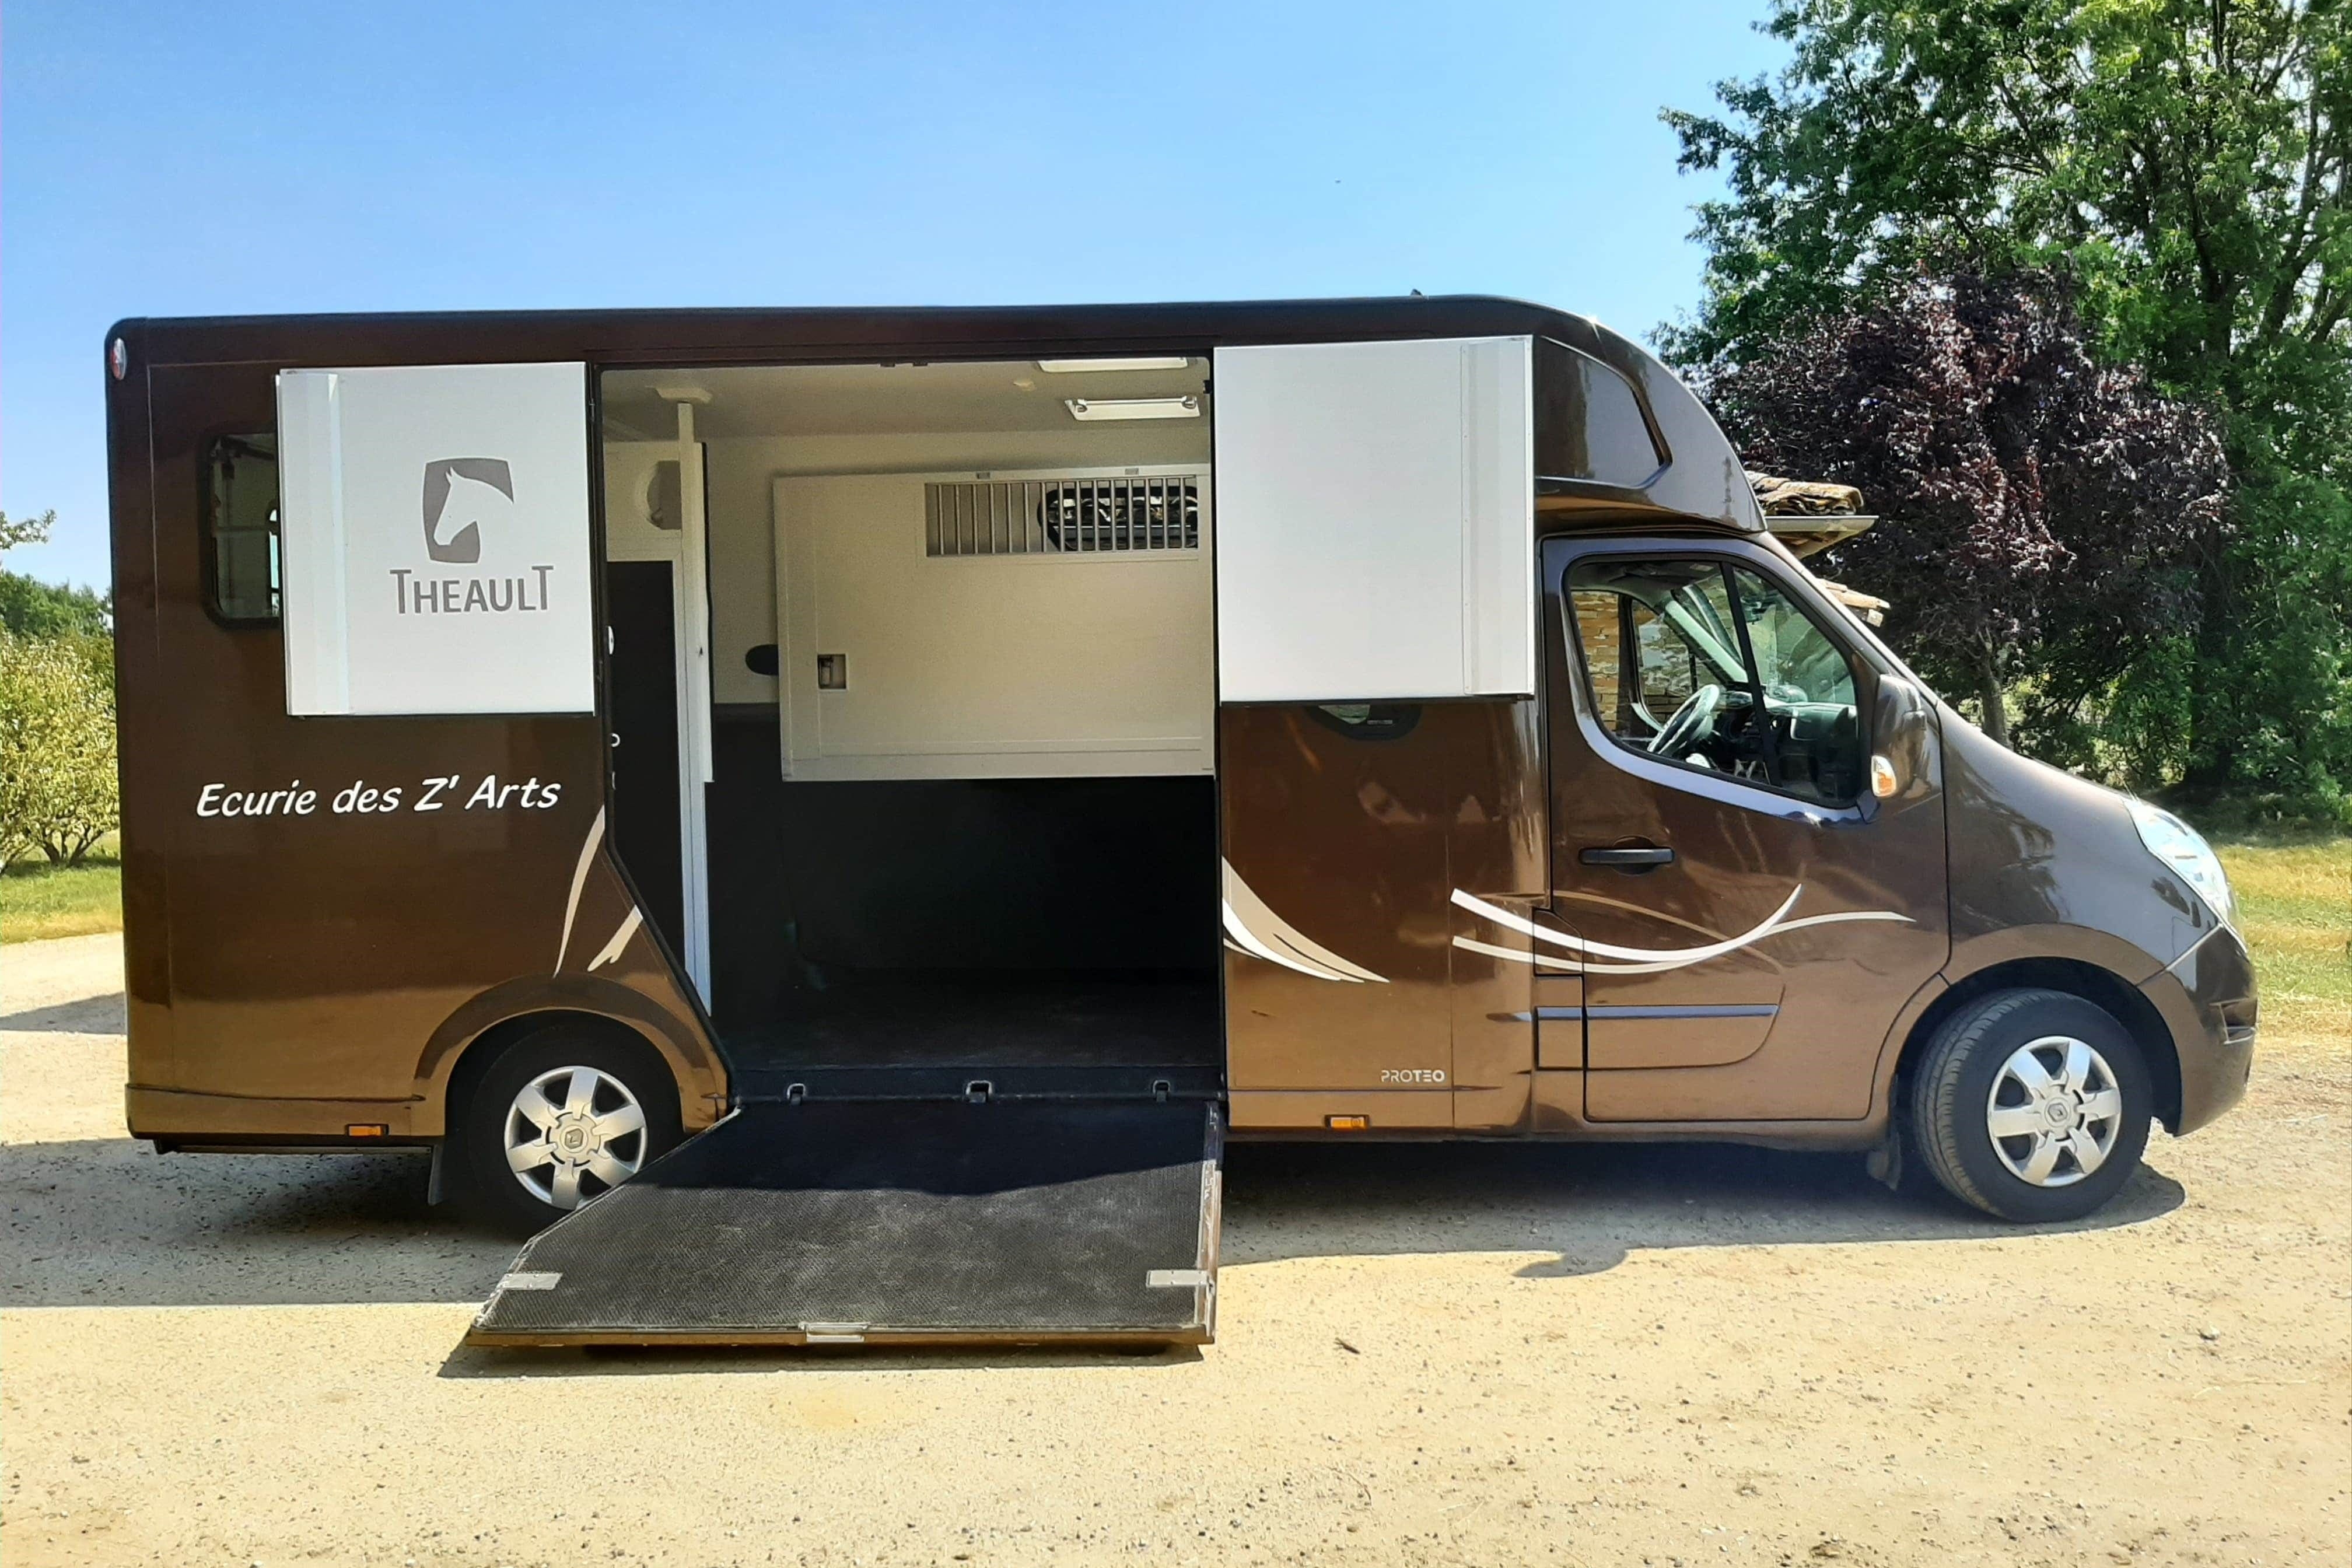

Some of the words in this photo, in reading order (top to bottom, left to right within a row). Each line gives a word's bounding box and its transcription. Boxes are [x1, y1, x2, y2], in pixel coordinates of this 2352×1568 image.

[389, 565, 554, 614] THEAULT
[196, 779, 317, 817] Ecurie
[331, 780, 402, 813] des
[413, 774, 460, 811] Z'
[464, 775, 561, 810] Arts
[1380, 1069, 1446, 1083] PROTEO
